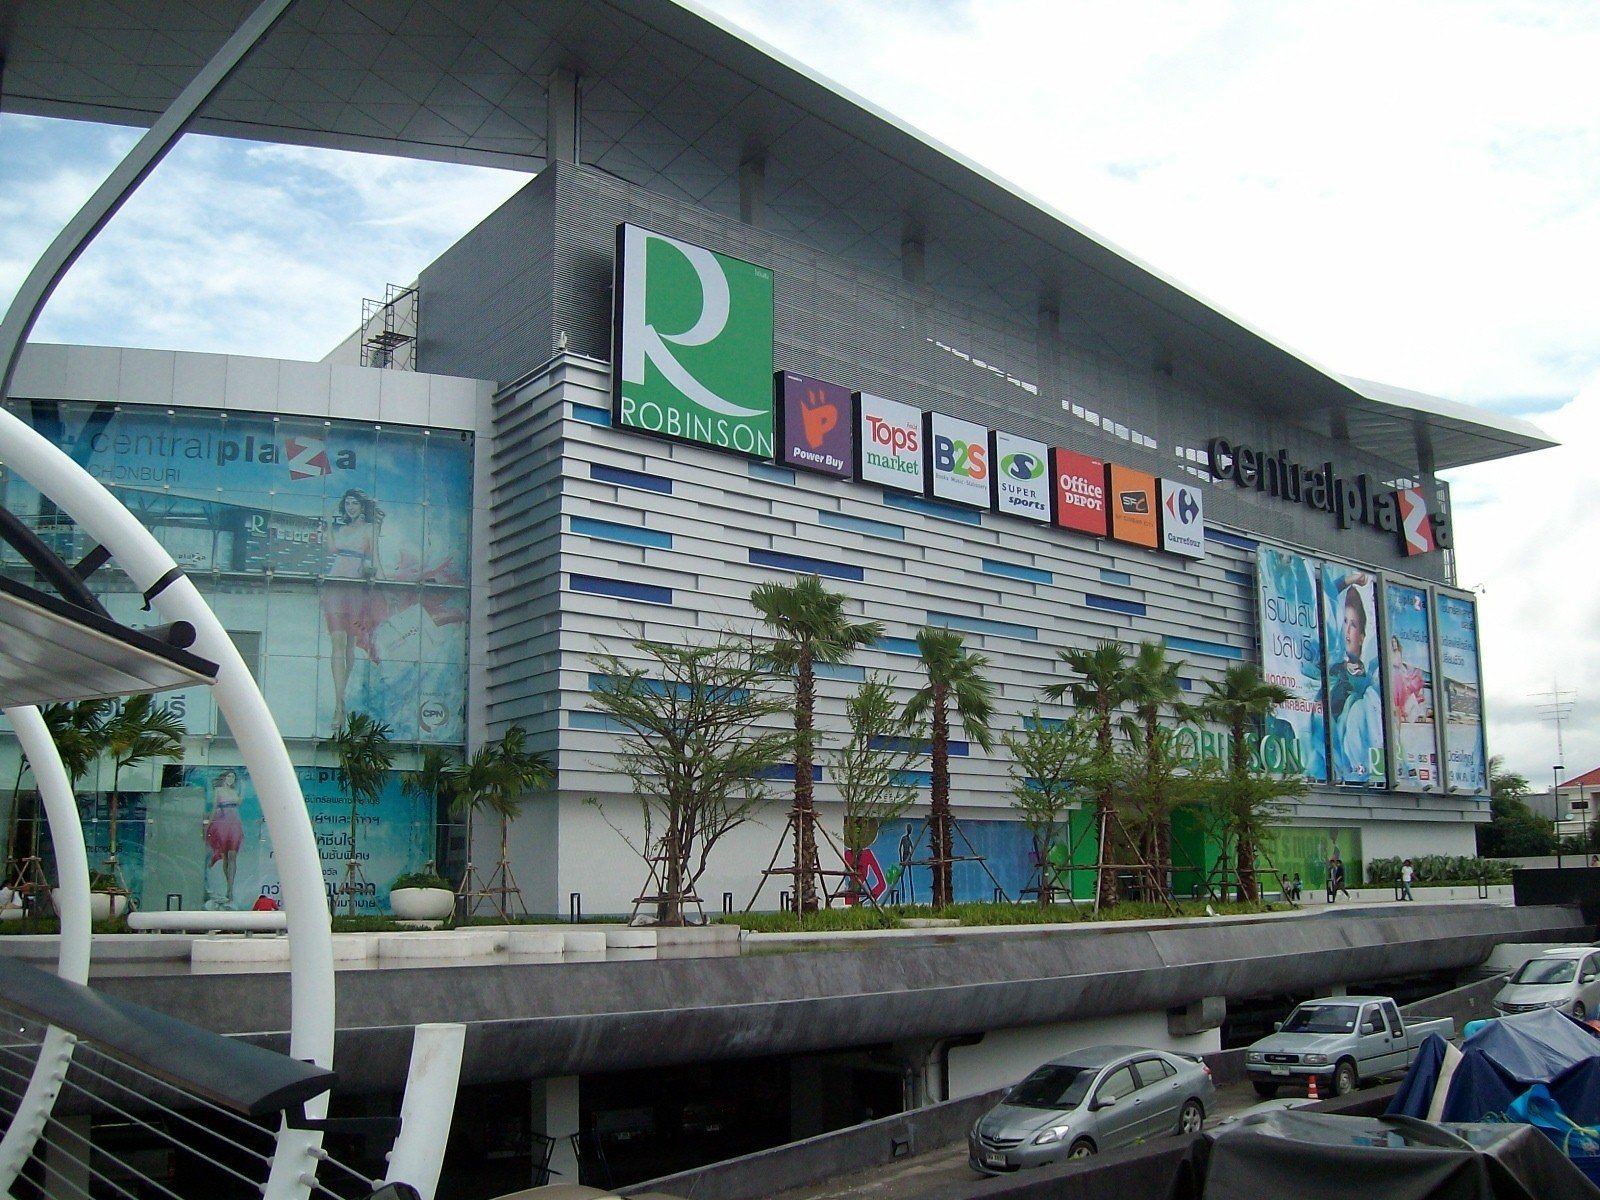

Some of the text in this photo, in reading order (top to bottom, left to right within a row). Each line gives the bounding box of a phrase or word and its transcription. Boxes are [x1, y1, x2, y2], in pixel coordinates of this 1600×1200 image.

[621, 396, 773, 457] ROBINSON
[866, 415, 918, 456] Tops
[793, 446, 844, 471] Power Buy
[867, 452, 919, 475] market
[935, 434, 987, 480] B2S
[87, 464, 181, 483] CHONBURI
[1001, 482, 1037, 499] SUPER
[1060, 474, 1103, 499] Office
[1009, 496, 1045, 511] sports
[1064, 491, 1103, 511] DEPOT
[1167, 532, 1201, 548] Carrefour
[423, 709, 443, 718] CPN
